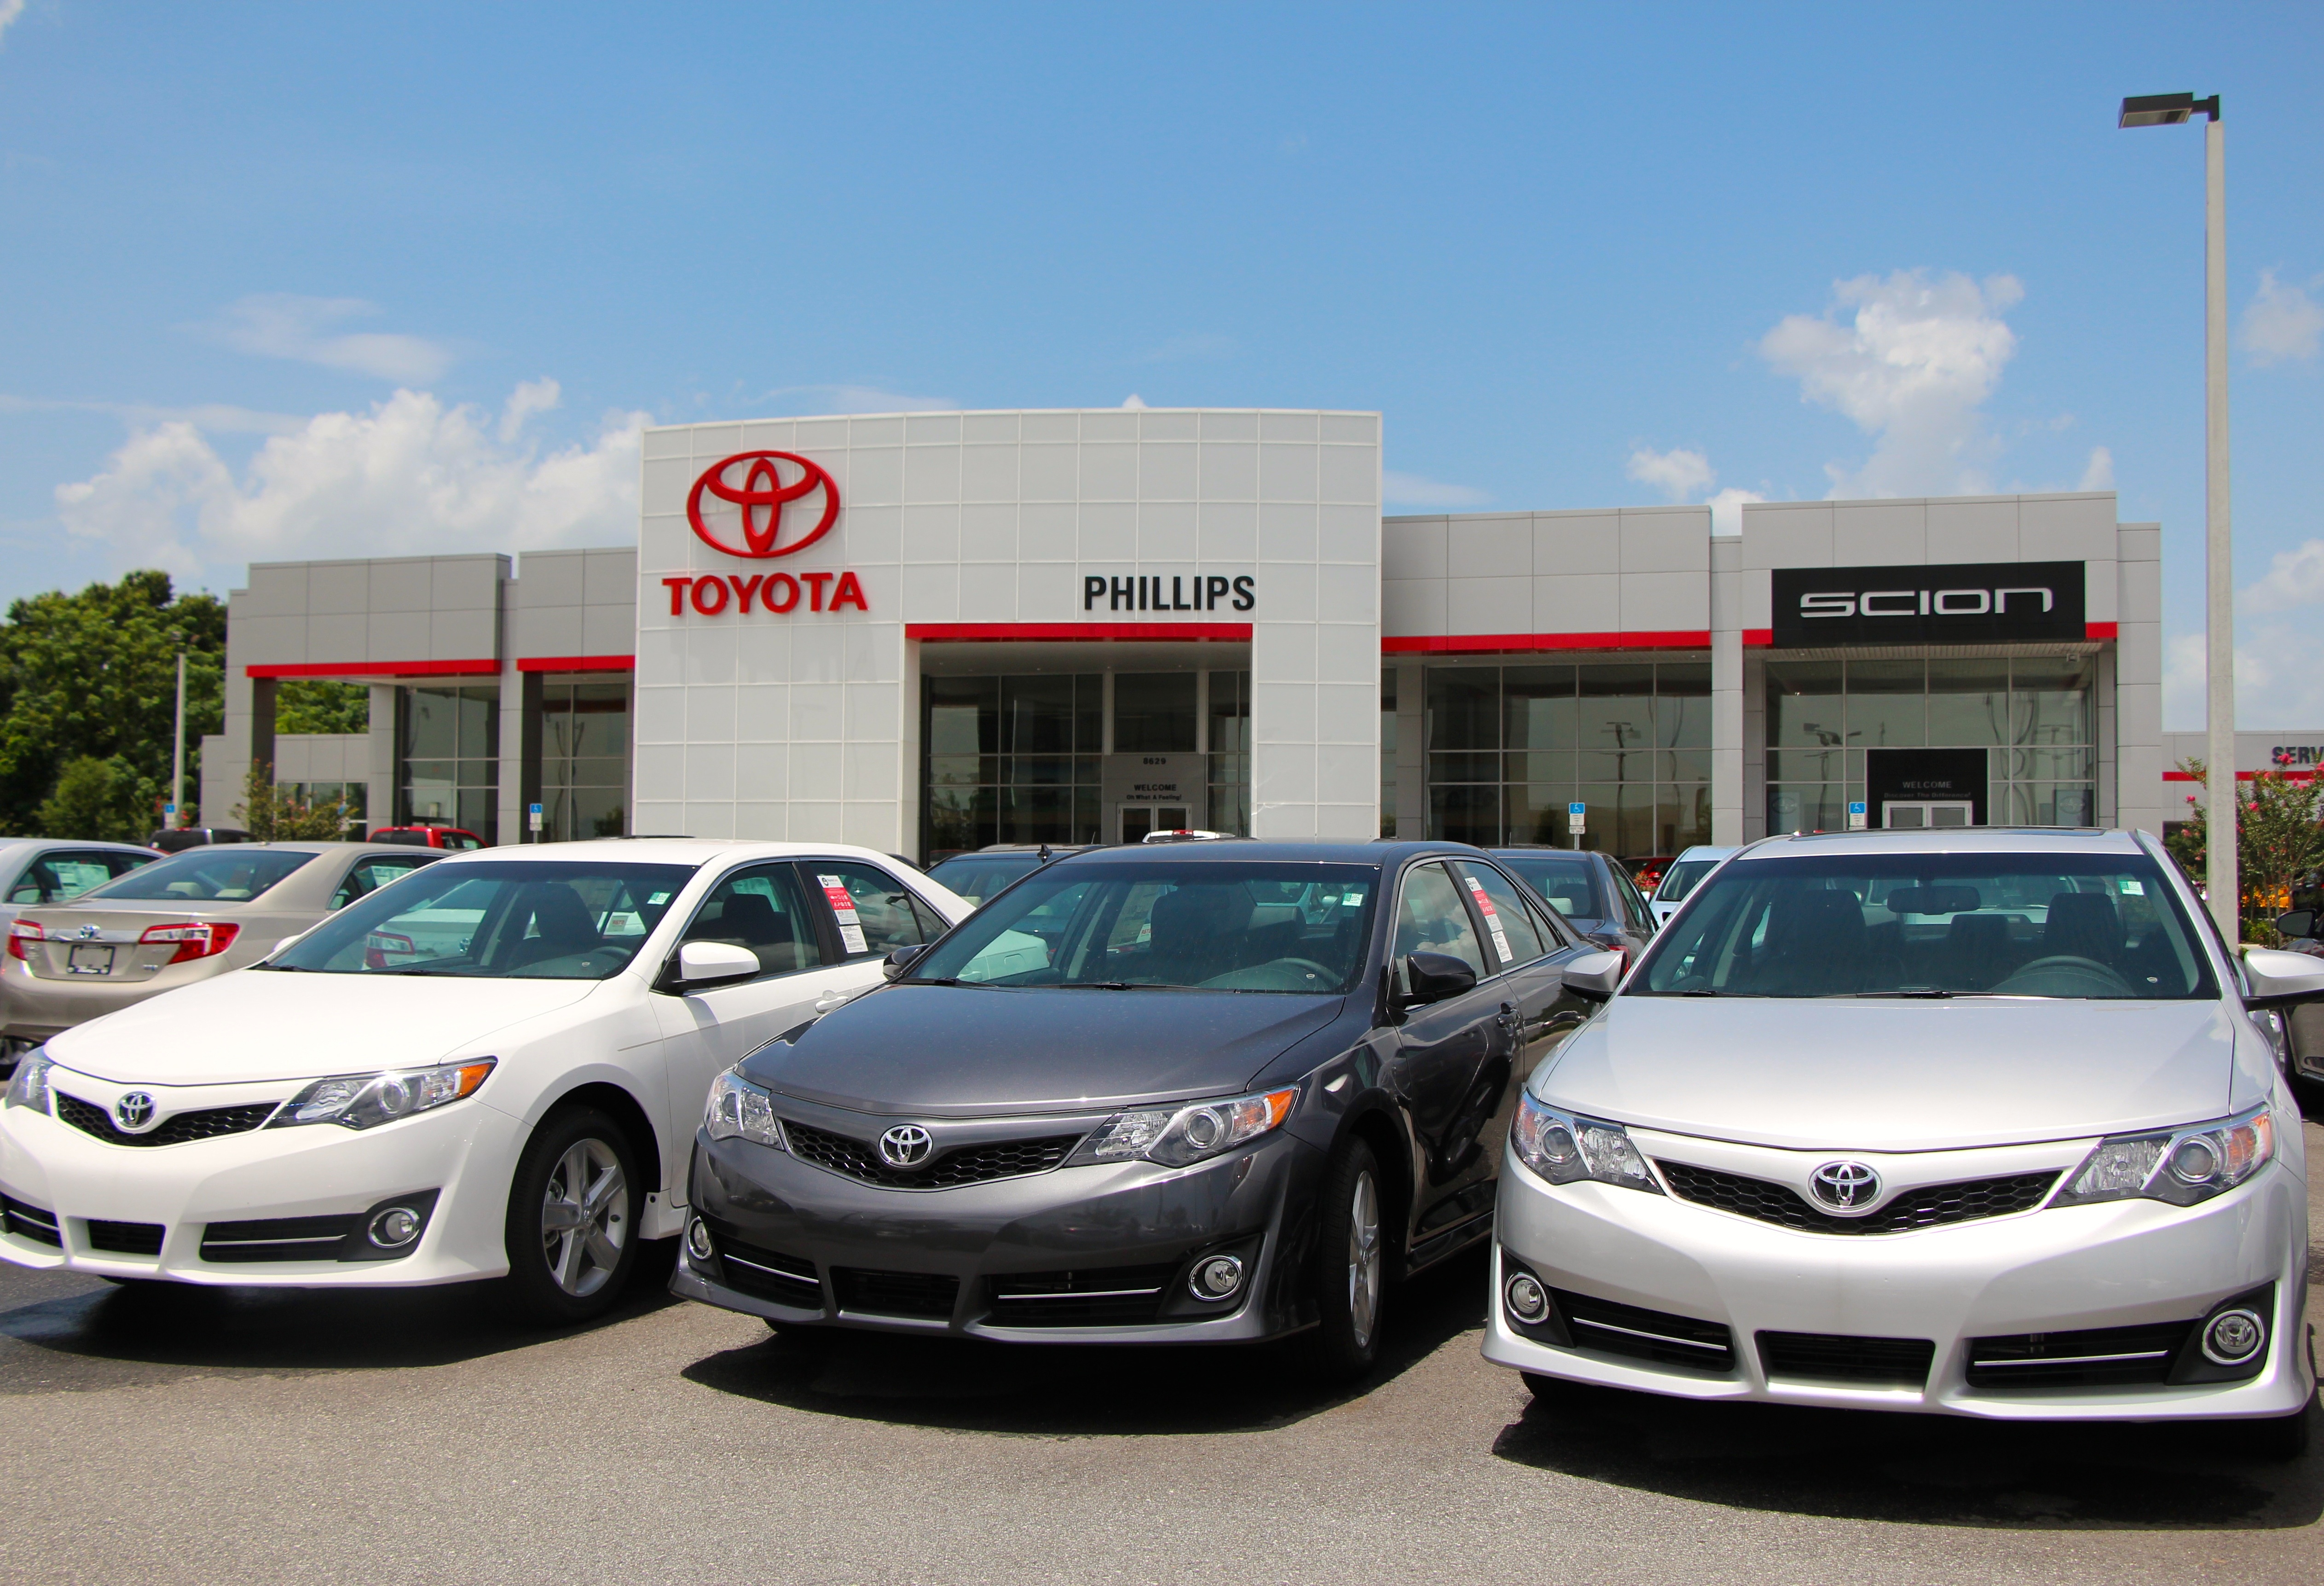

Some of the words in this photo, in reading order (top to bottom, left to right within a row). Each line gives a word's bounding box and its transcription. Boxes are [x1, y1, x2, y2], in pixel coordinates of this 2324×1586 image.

[662, 572, 869, 616] TOYOTA
[1084, 576, 1254, 610] PHILLIPS
[1800, 588, 2053, 618] SCION
